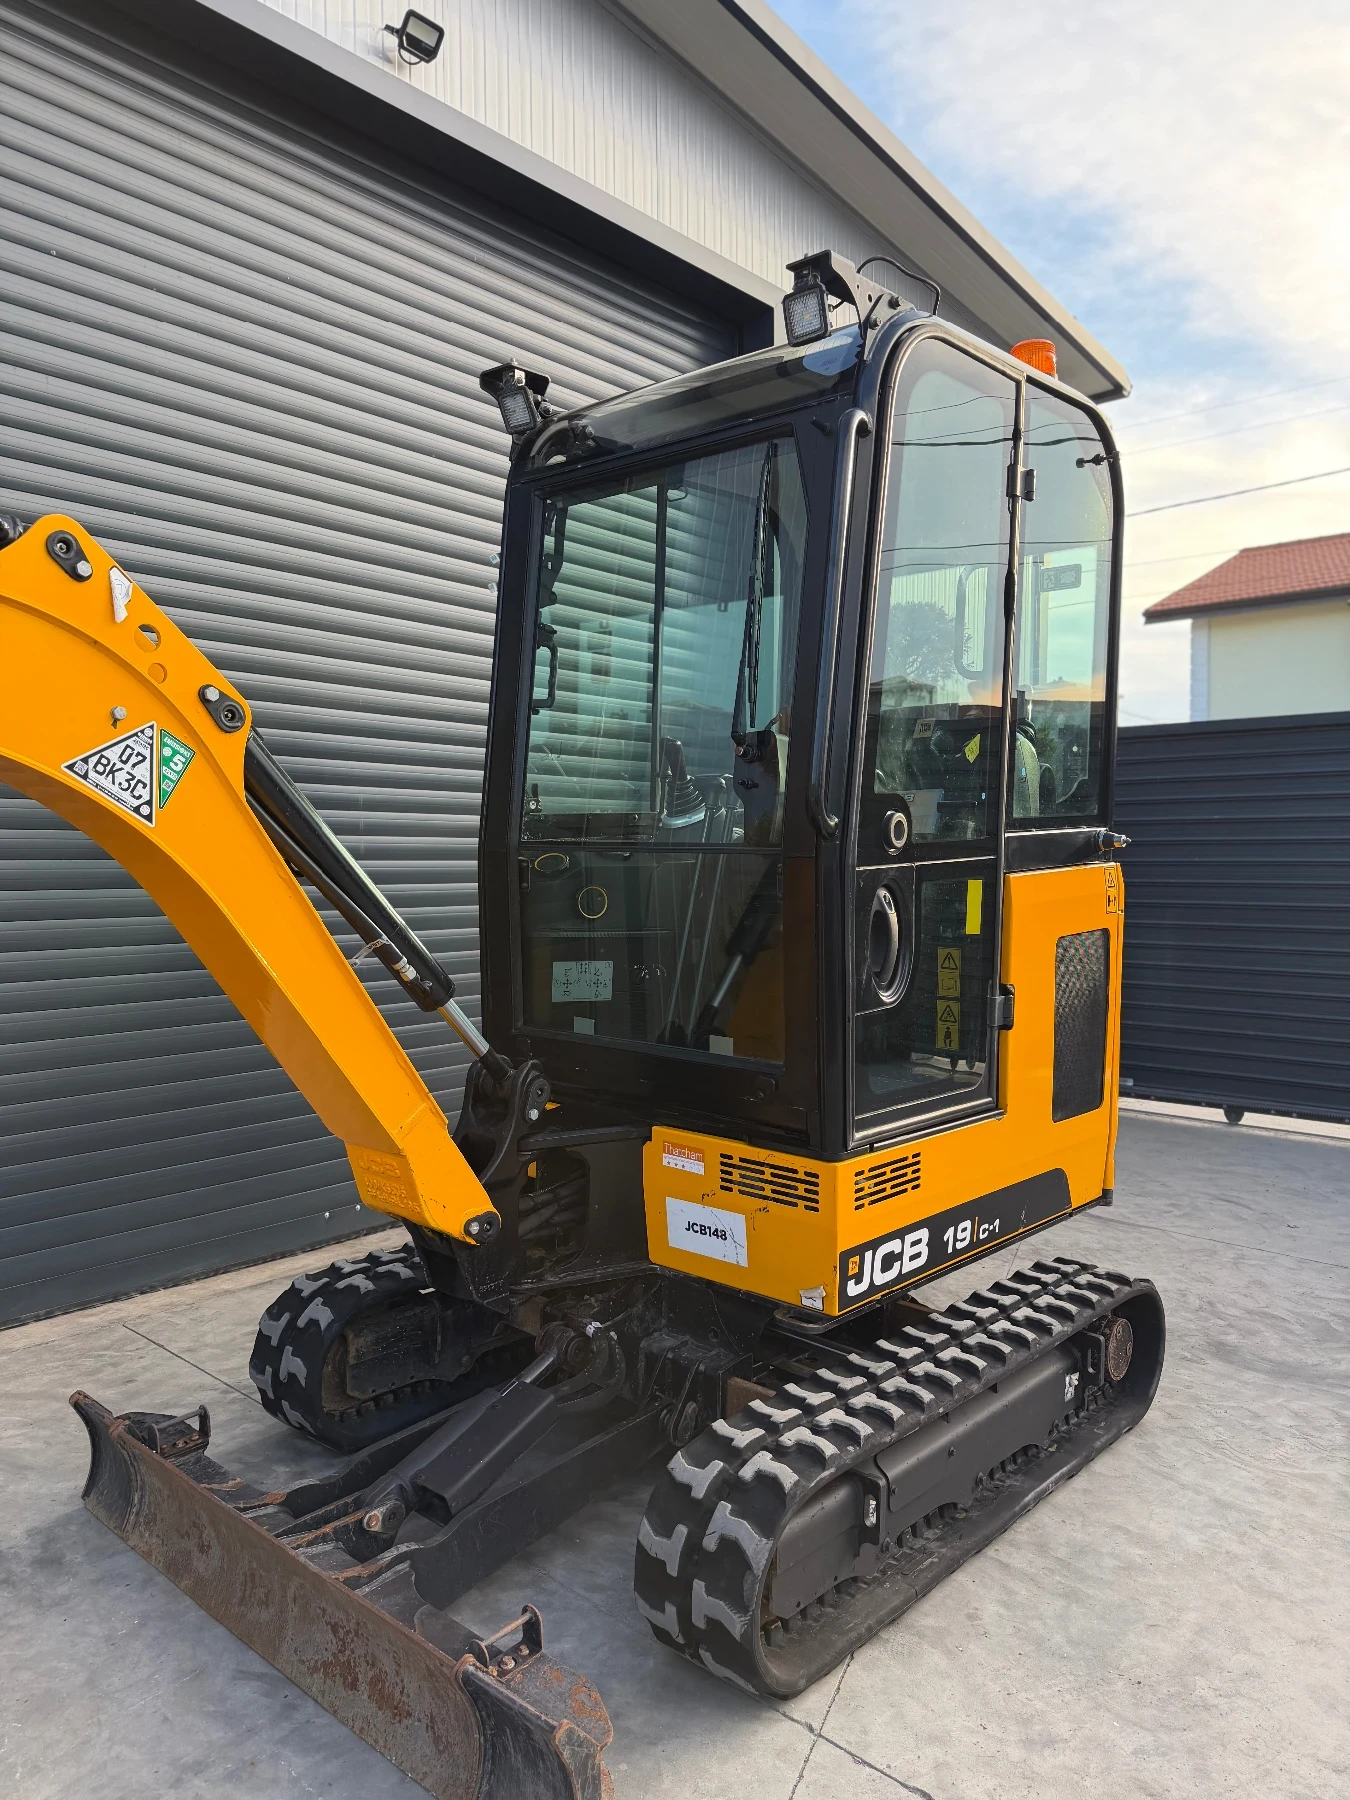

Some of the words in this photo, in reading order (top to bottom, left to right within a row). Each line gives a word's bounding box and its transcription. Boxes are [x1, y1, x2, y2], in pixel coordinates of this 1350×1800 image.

[118, 743, 148, 771] 07
[169, 753, 186, 772] 5
[91, 753, 148, 801] BK3C
[664, 1142, 703, 1162] Thatcham
[685, 1220, 728, 1241] JCB148
[846, 1227, 930, 1297] JCB
[943, 1219, 972, 1254] 19
